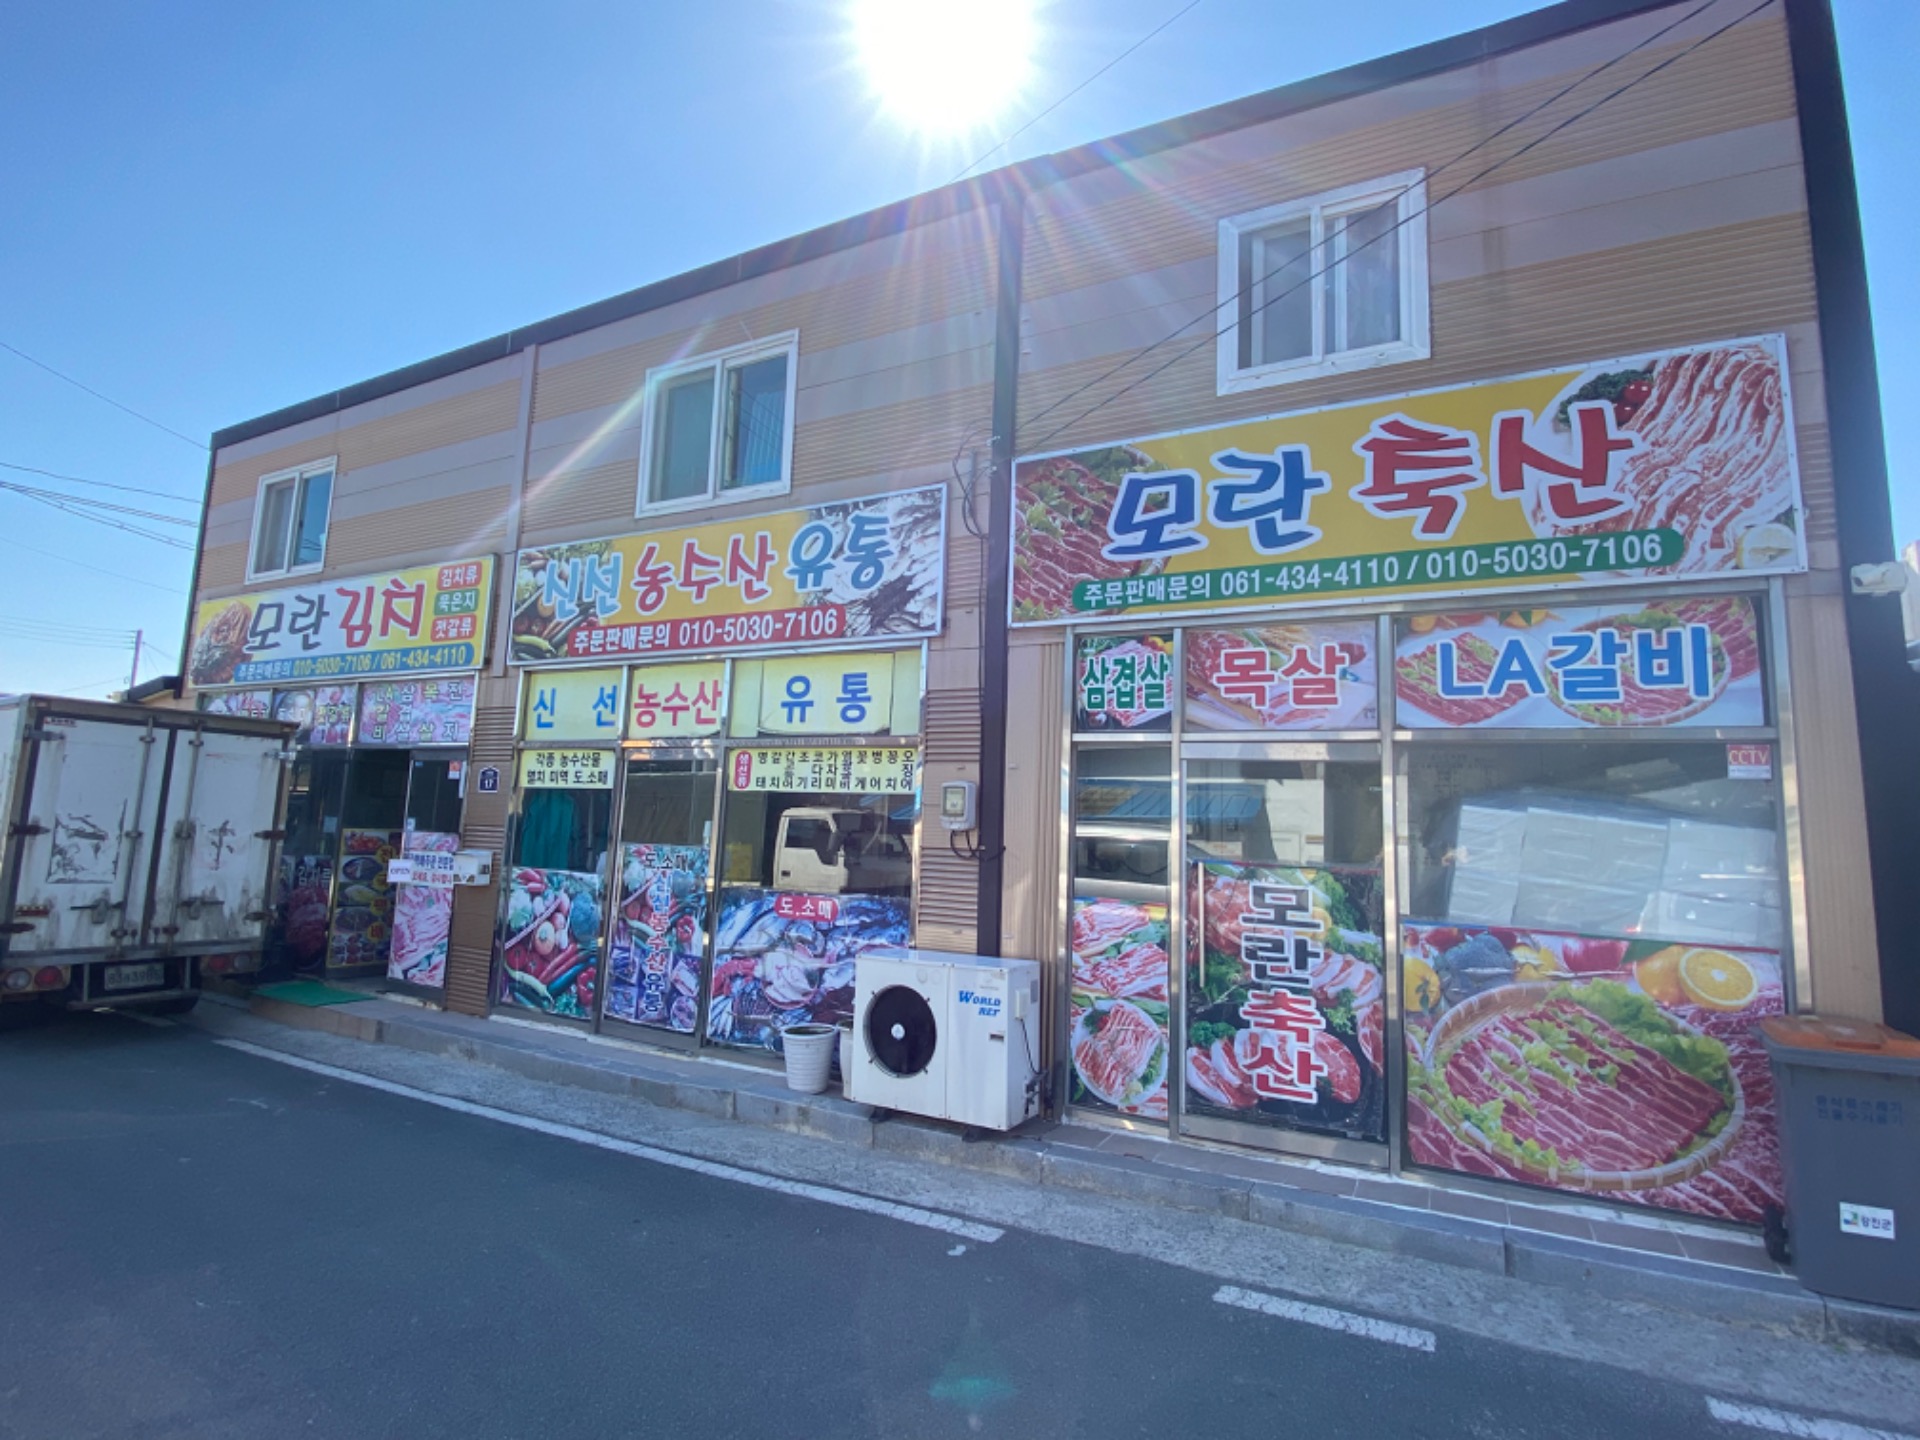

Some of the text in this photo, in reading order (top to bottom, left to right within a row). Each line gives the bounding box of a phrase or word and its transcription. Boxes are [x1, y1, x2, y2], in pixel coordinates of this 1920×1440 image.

[1105, 406, 1633, 553] 모란 축산
[544, 514, 892, 619] 신선 농수산 유통
[1083, 574, 1212, 607] 주문판매문의
[1220, 556, 1399, 597] 061-434-4110
[1425, 533, 1663, 579] 010-5030-7106
[245, 578, 425, 651] 모란 김치
[573, 608, 839, 653] 주문판매문의 010-5030-7106
[380, 645, 466, 670] 061-434-4110
[1214, 644, 1348, 707] 목살
[1440, 624, 1710, 702] LA갈비
[1082, 653, 1169, 710] 삼겹살
[633, 679, 722, 727] 농수산
[560, 752, 601, 768] 농수산물
[811, 751, 822, 789] 코다리
[824, 751, 838, 789] 가자미
[855, 751, 867, 789] 꽃게
[868, 751, 882, 789] 병어
[885, 751, 897, 791] 꽁치
[900, 751, 915, 791] 오징어
[1729, 750, 1768, 765] CCTV
[779, 896, 832, 920] 도.소매
[958, 990, 1001, 1007] WORLD
[1241, 882, 1328, 1104] 모란축산
